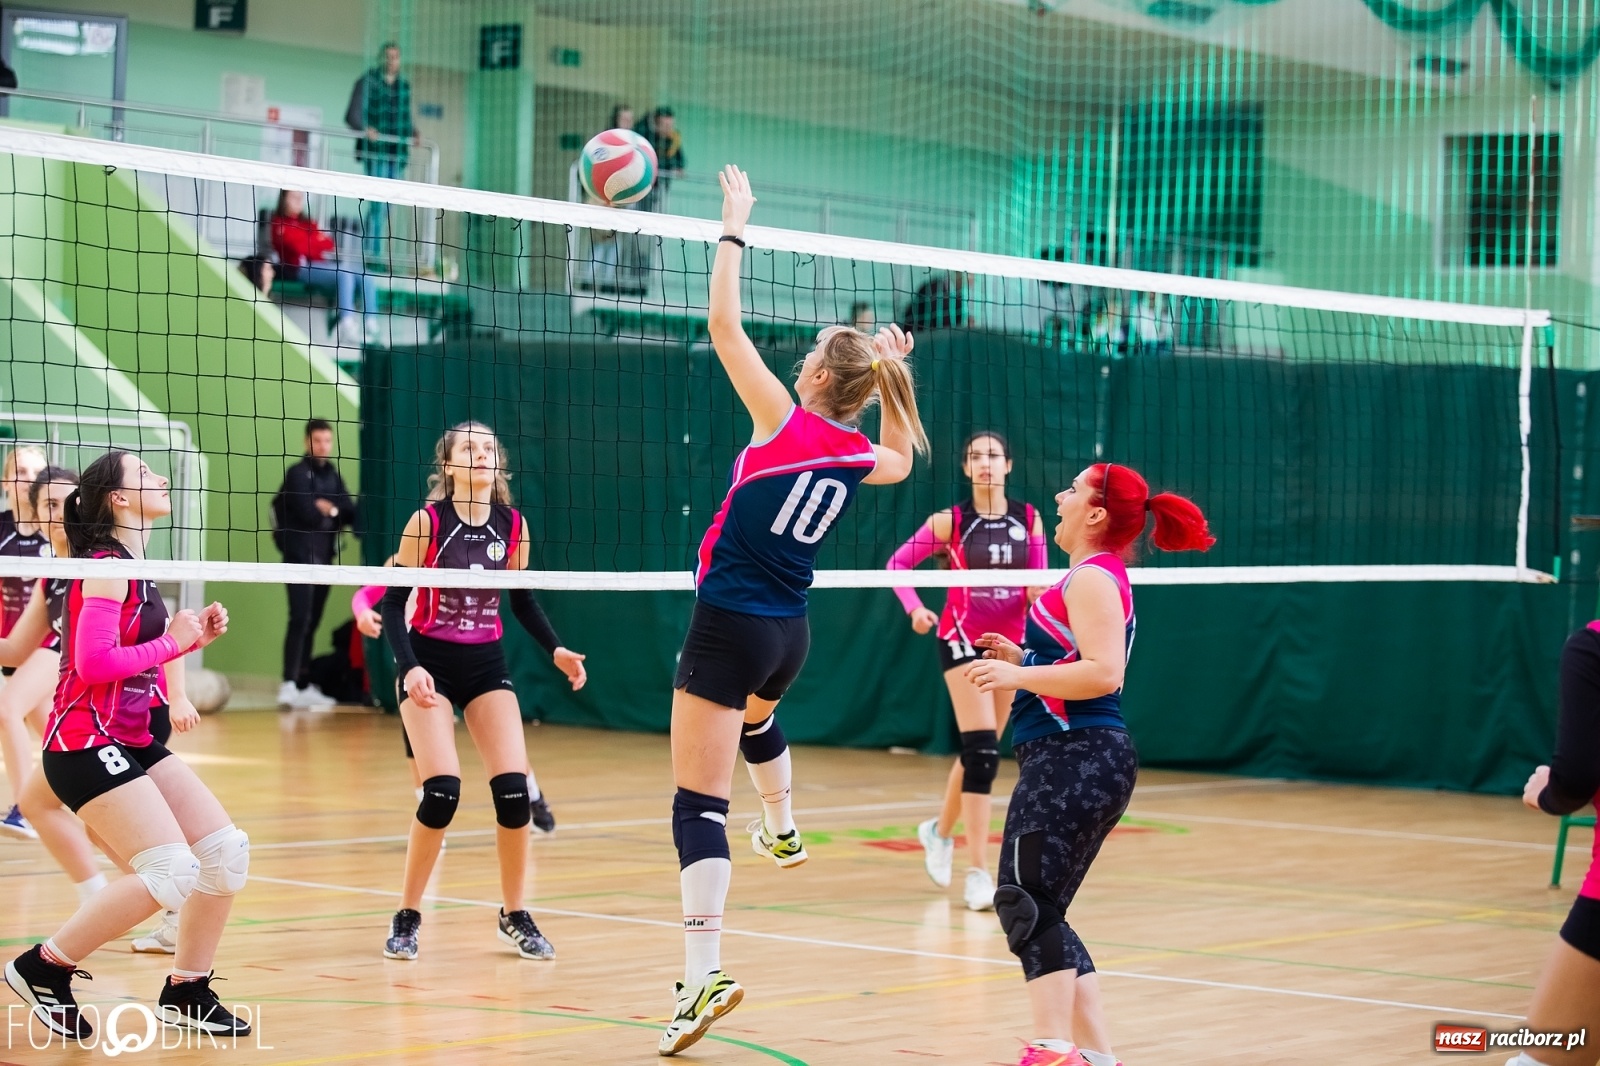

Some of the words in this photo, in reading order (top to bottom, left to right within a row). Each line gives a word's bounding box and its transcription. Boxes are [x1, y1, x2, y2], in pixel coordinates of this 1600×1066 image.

[209, 7, 233, 28] F
[770, 470, 847, 544] 10
[988, 543, 1013, 564] 11
[948, 640, 976, 660] 11
[98, 745, 130, 775] 8
